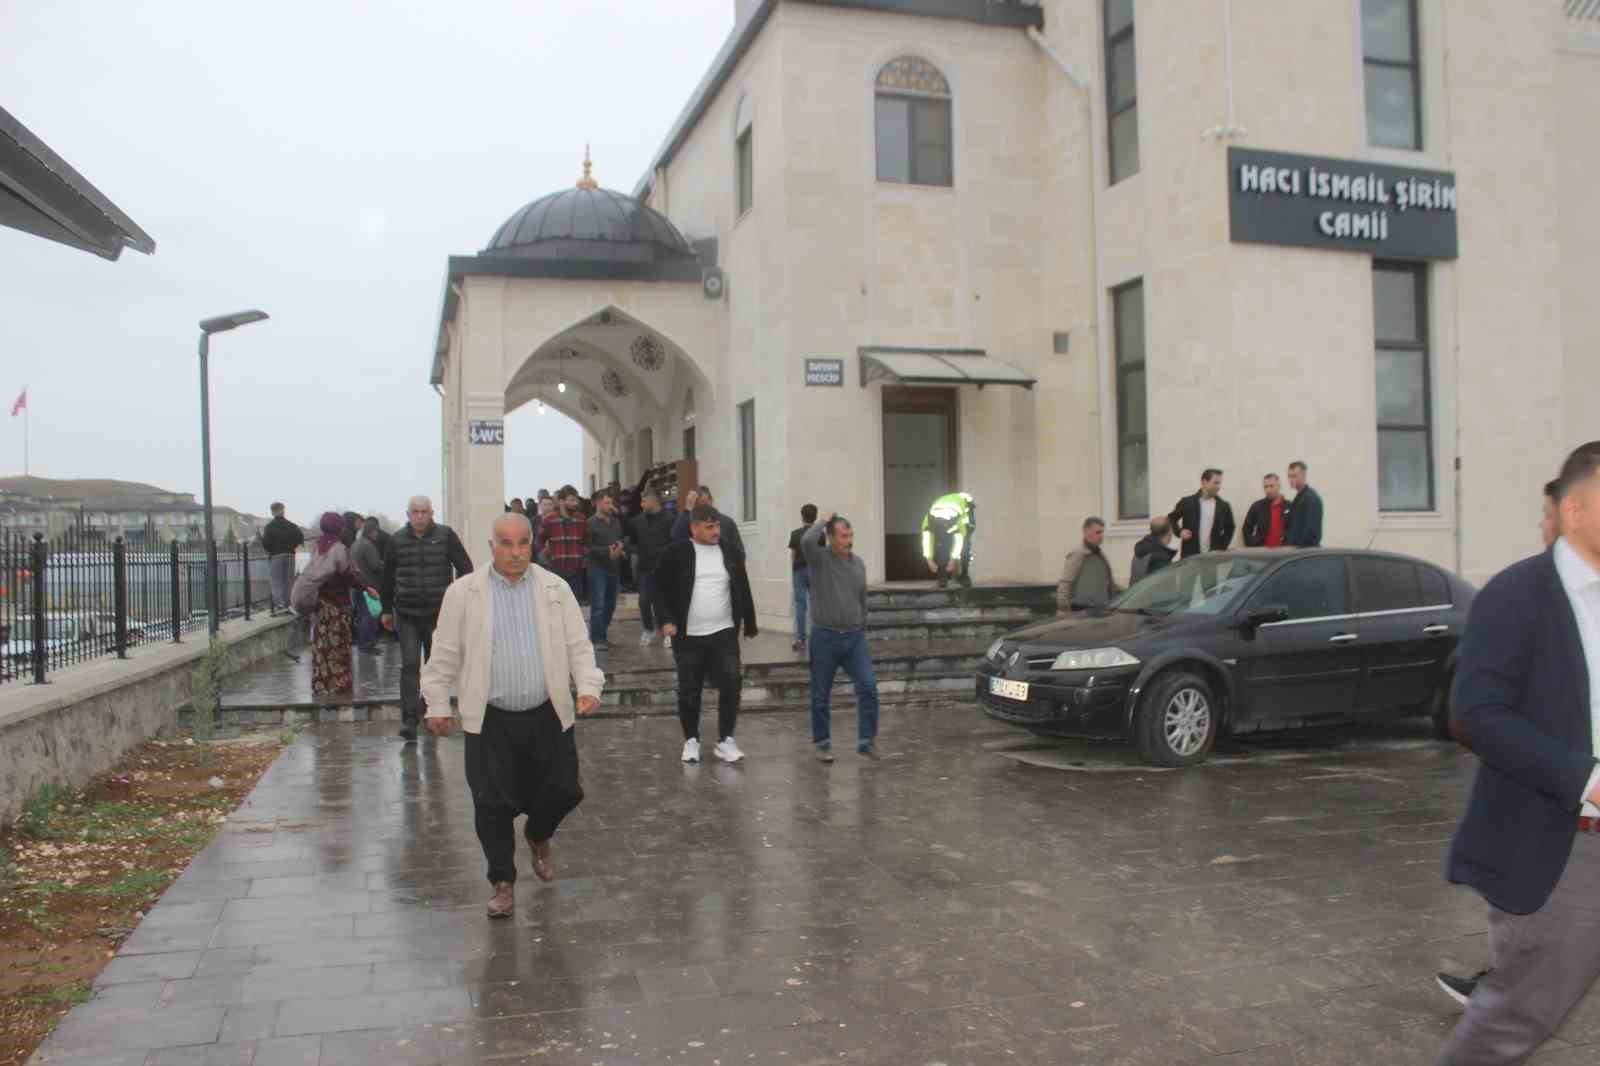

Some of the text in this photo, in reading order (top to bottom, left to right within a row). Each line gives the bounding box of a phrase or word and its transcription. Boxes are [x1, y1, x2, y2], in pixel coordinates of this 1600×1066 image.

[1241, 164, 1300, 194] HACI
[1309, 167, 1389, 204] İSMAİL
[1319, 211, 1389, 240] CAMİİ
[480, 429, 503, 442] WC
